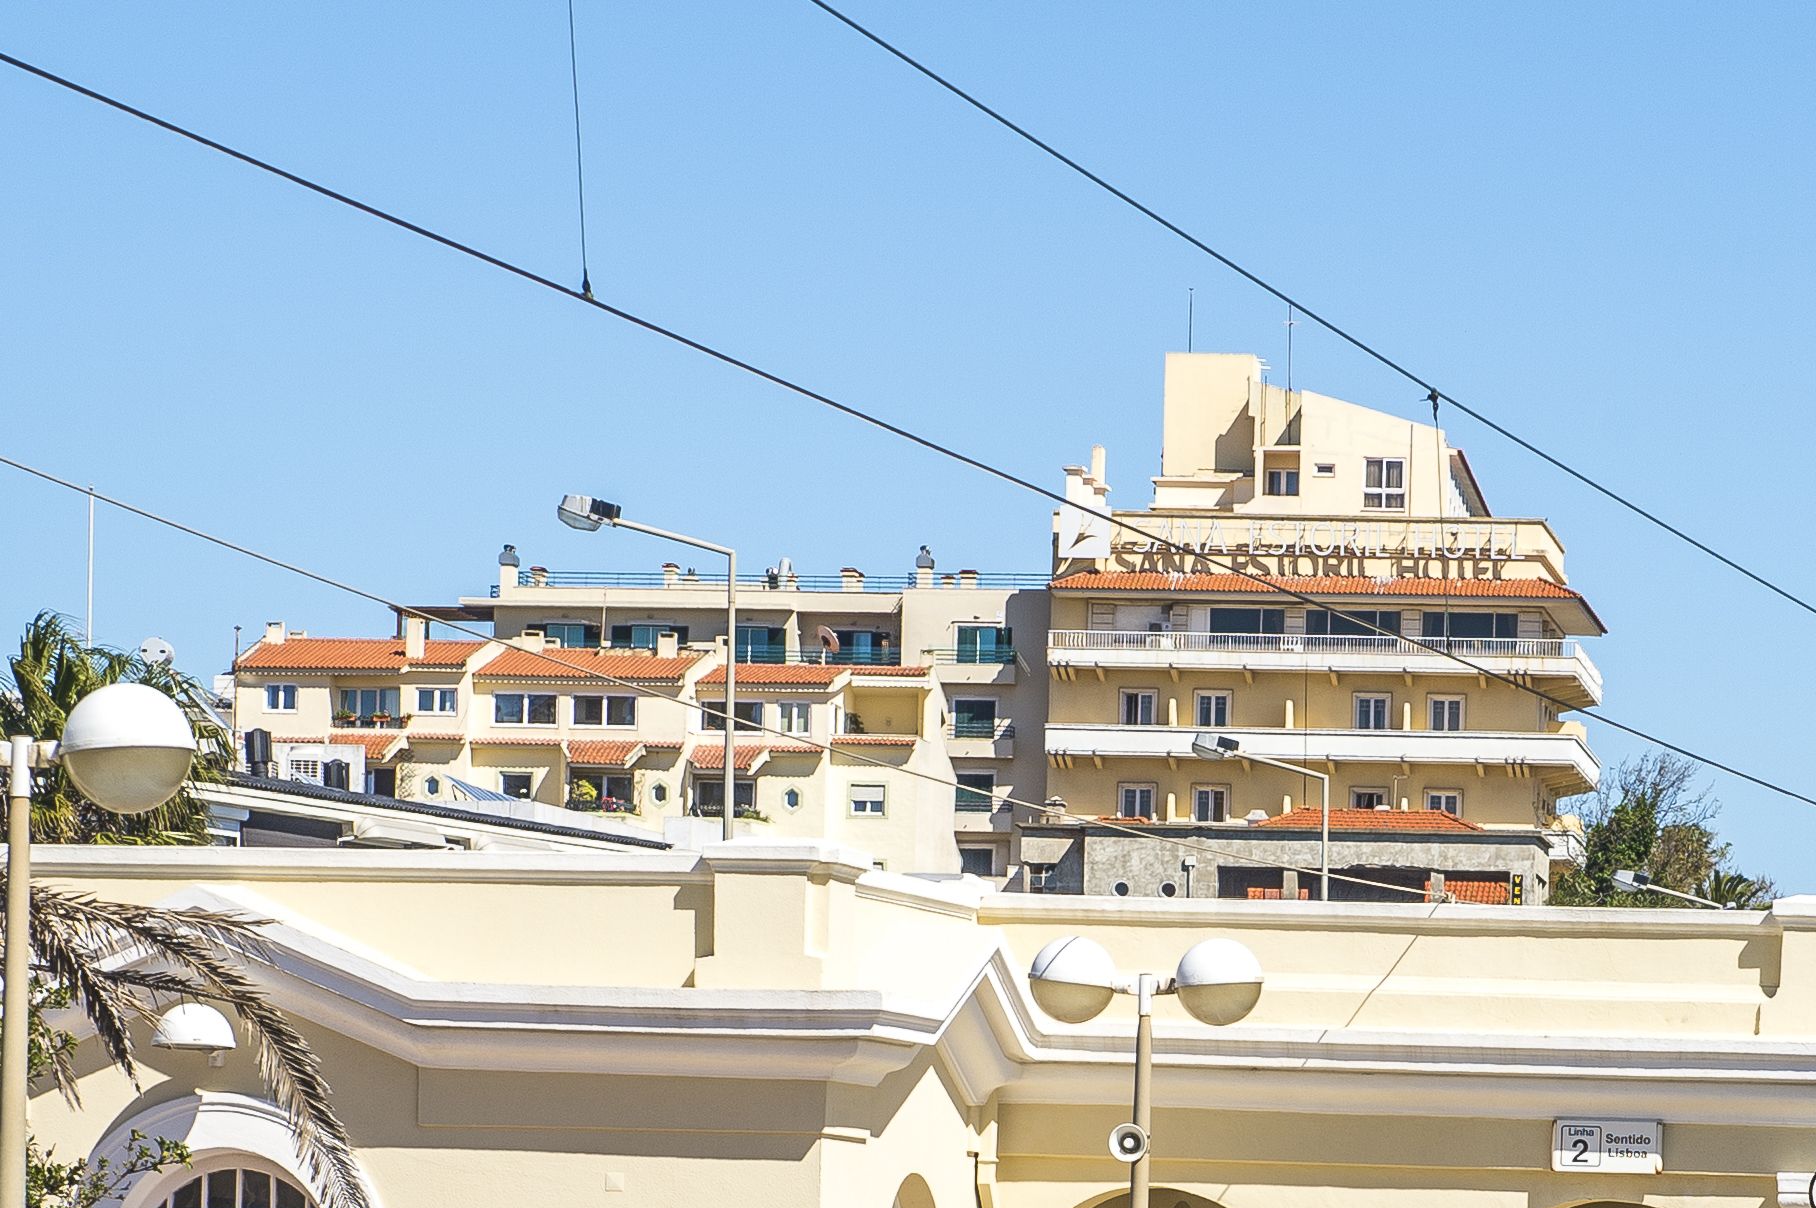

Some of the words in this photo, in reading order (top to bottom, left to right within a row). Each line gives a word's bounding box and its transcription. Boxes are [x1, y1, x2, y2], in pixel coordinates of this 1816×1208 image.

[1132, 520, 1227, 553] SANA
[1248, 521, 1390, 557] ESTORIL
[1413, 523, 1525, 560] HOTEL
[1568, 1128, 1595, 1136] Linha
[1605, 1133, 1651, 1145] Sentido
[1571, 1138, 1589, 1162] 2
[1607, 1147, 1648, 1158] Lisboa
